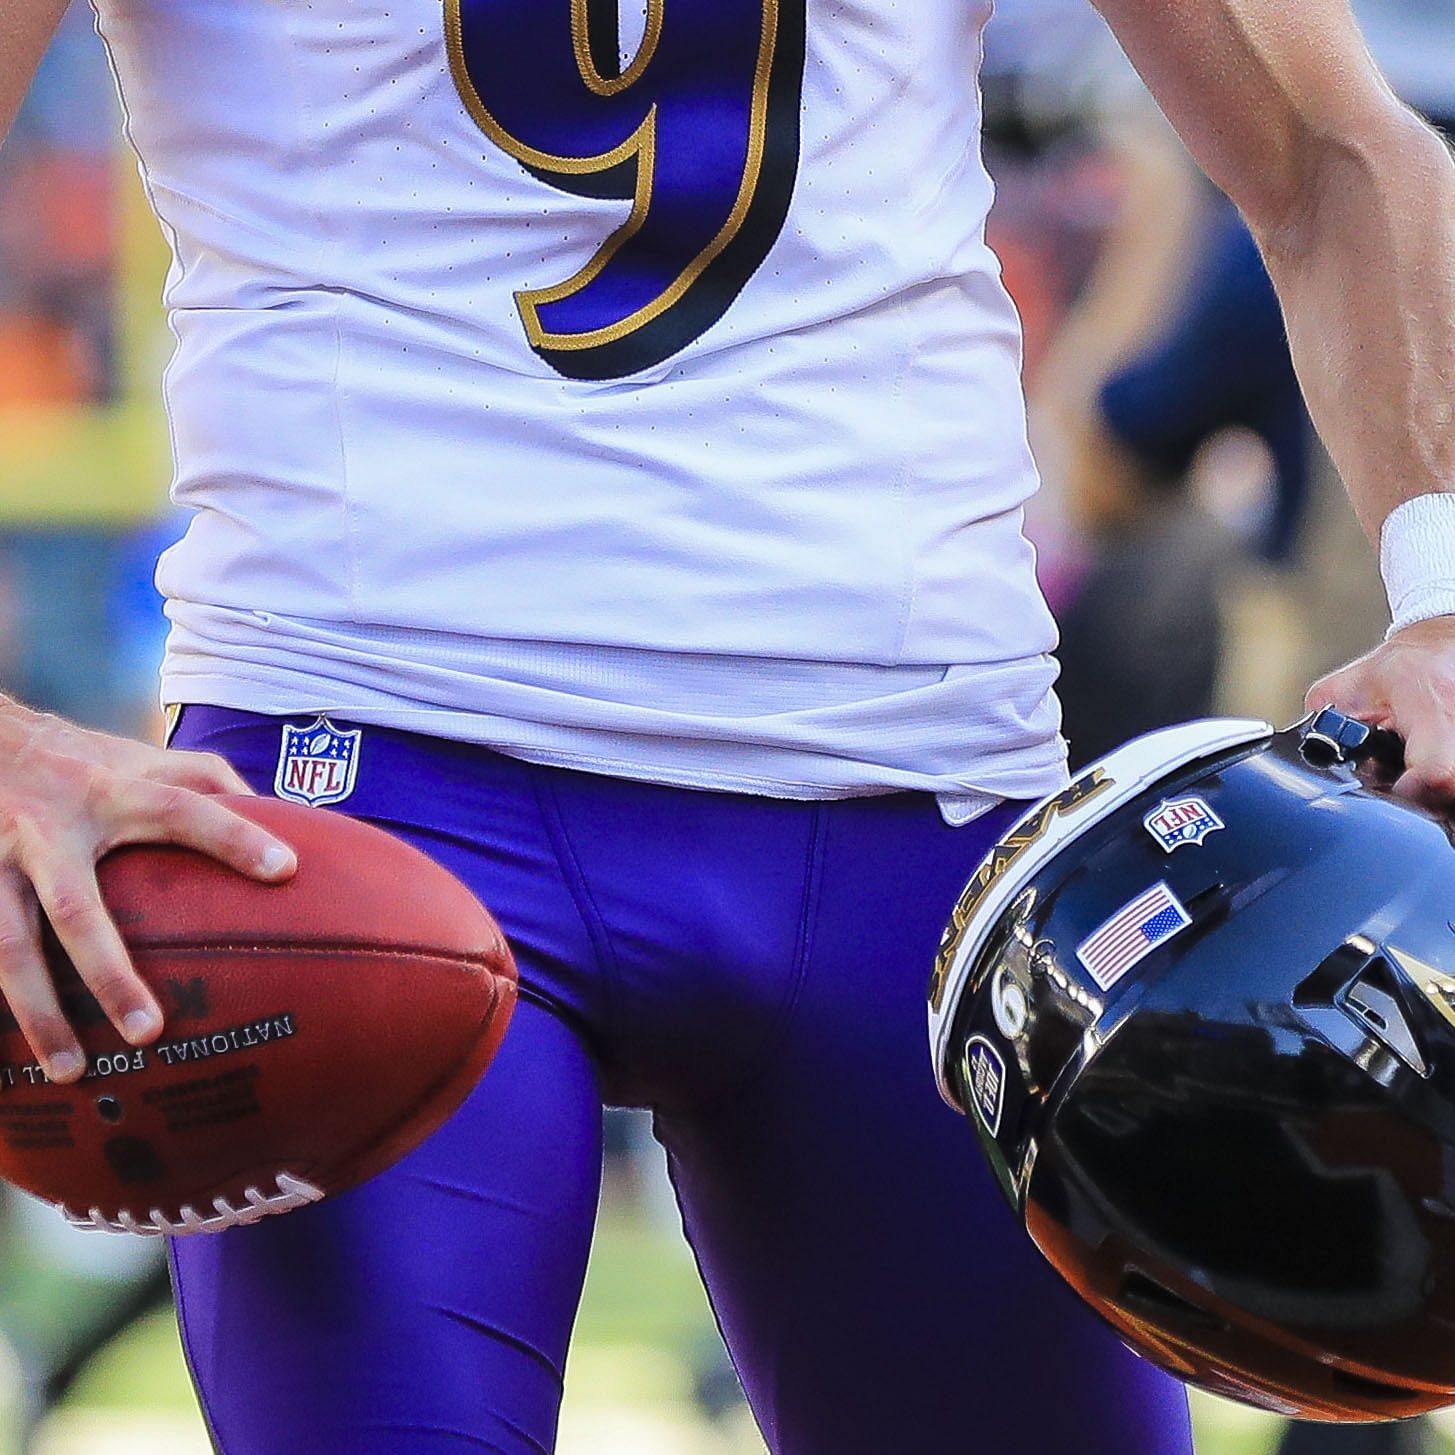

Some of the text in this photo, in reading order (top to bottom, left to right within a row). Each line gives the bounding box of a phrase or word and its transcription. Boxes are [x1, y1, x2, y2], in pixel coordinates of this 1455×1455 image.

[287, 759, 342, 795] NFL
[1153, 804, 1204, 831] NFL
[157, 1015, 294, 1065] NATIONAL
